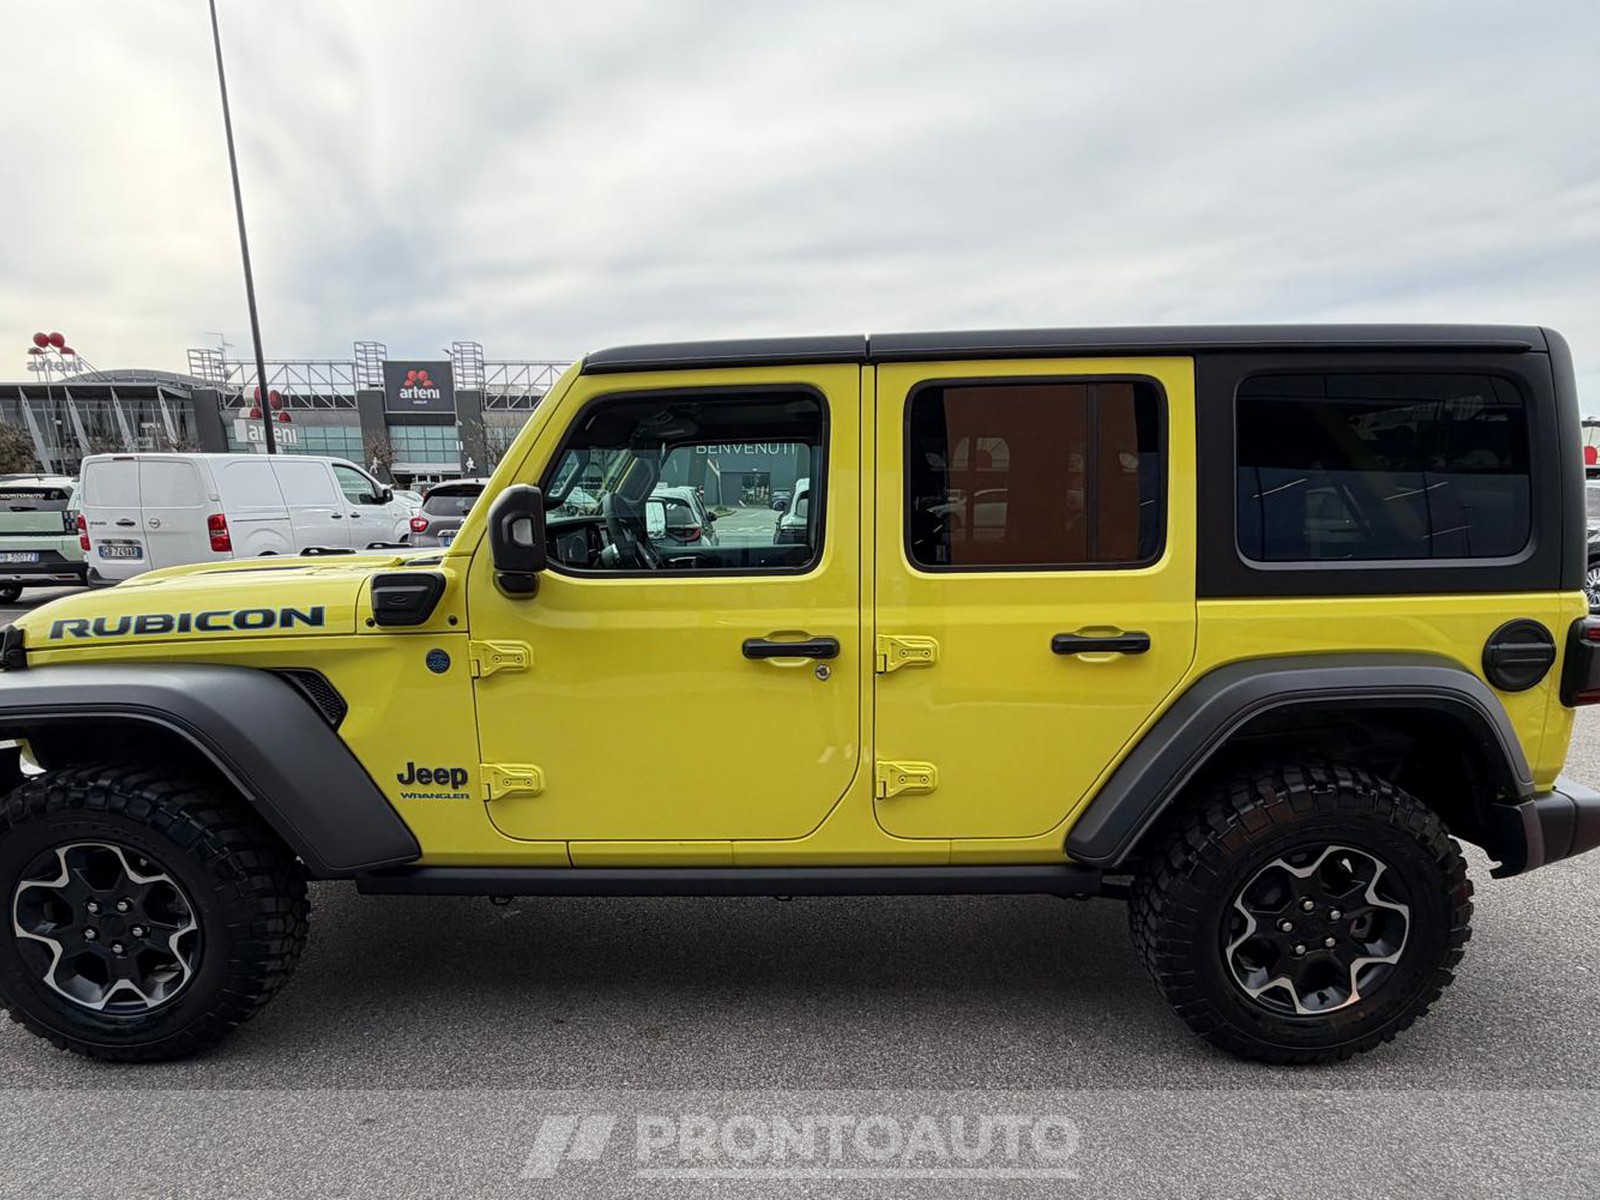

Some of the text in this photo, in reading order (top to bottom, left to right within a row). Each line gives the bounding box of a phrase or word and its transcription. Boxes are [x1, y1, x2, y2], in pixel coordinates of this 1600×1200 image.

[399, 385, 440, 399] arteni
[248, 424, 297, 444] areni
[49, 606, 325, 639] RUBICON
[397, 761, 468, 790] Jeep
